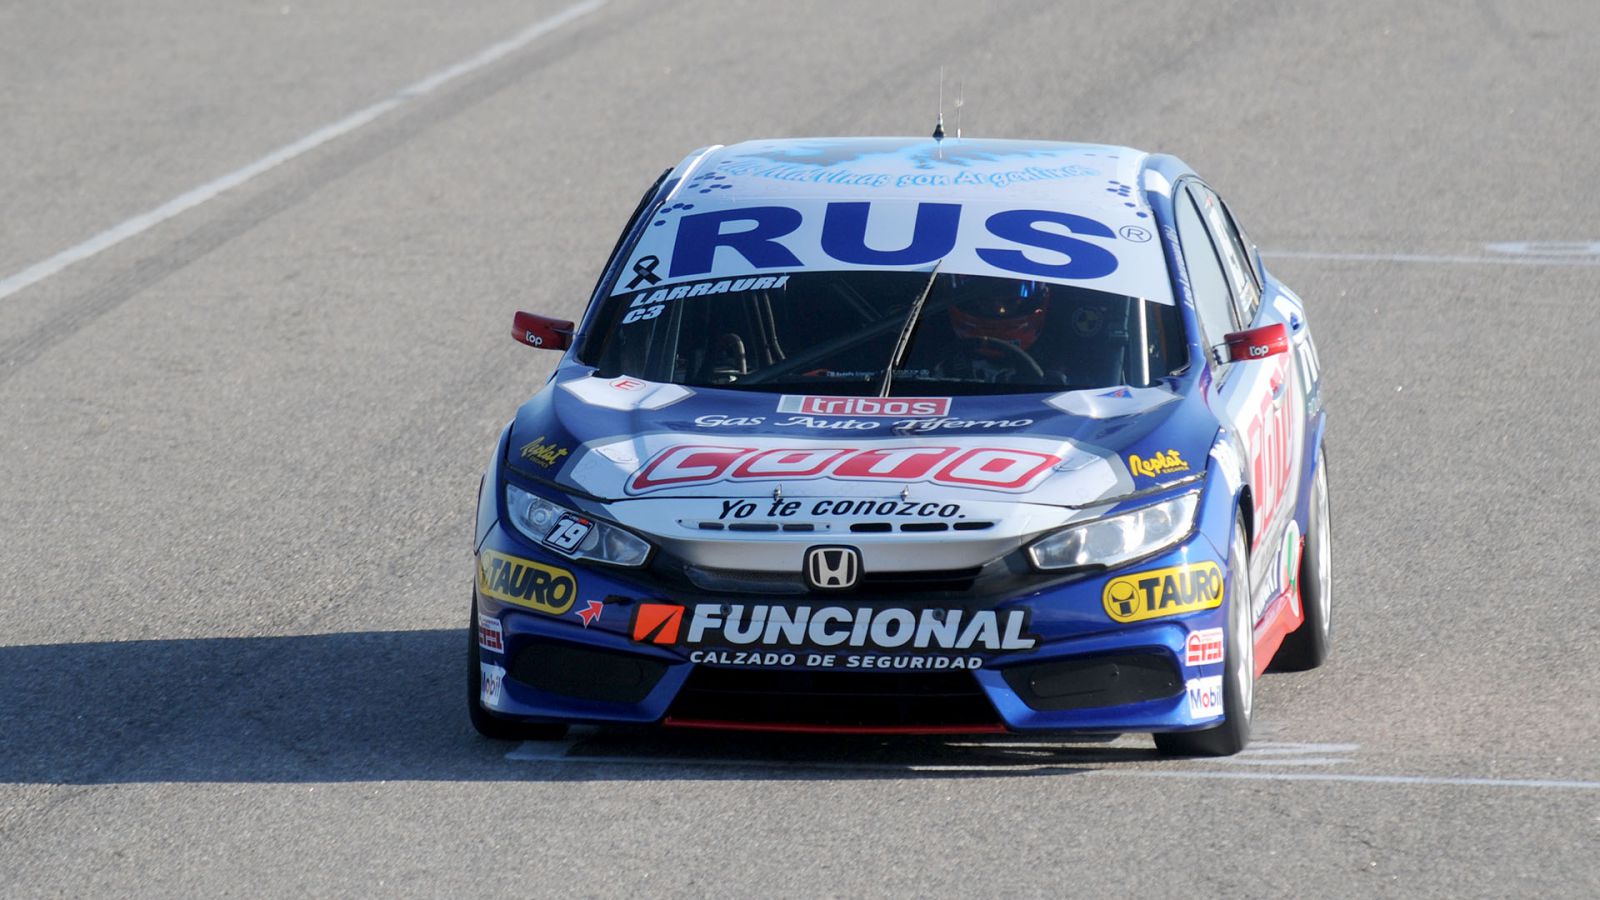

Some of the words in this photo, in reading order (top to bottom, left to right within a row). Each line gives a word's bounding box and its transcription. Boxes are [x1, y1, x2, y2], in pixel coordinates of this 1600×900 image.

[896, 174, 948, 187] son
[668, 201, 1119, 280] RUS
[630, 275, 791, 308] LARRAURI
[622, 304, 665, 325] C3
[811, 398, 938, 415] tribos
[694, 414, 767, 428] Gas
[774, 414, 880, 430] Auto
[892, 416, 1034, 431] Tiferno
[630, 443, 1062, 492] COTO
[1128, 449, 1188, 478] Replat
[719, 499, 758, 519] Yo
[767, 499, 799, 517] te
[811, 500, 967, 518] conozco.
[546, 518, 589, 550] 19
[489, 558, 574, 608] TAURO
[1138, 567, 1222, 611] TAURO
[686, 603, 1036, 650] FUNCIONAL
[689, 651, 796, 666] CALZADO
[806, 654, 836, 668] DE
[846, 655, 984, 670] SEGURIDAD
[1189, 684, 1222, 709] Mobil
